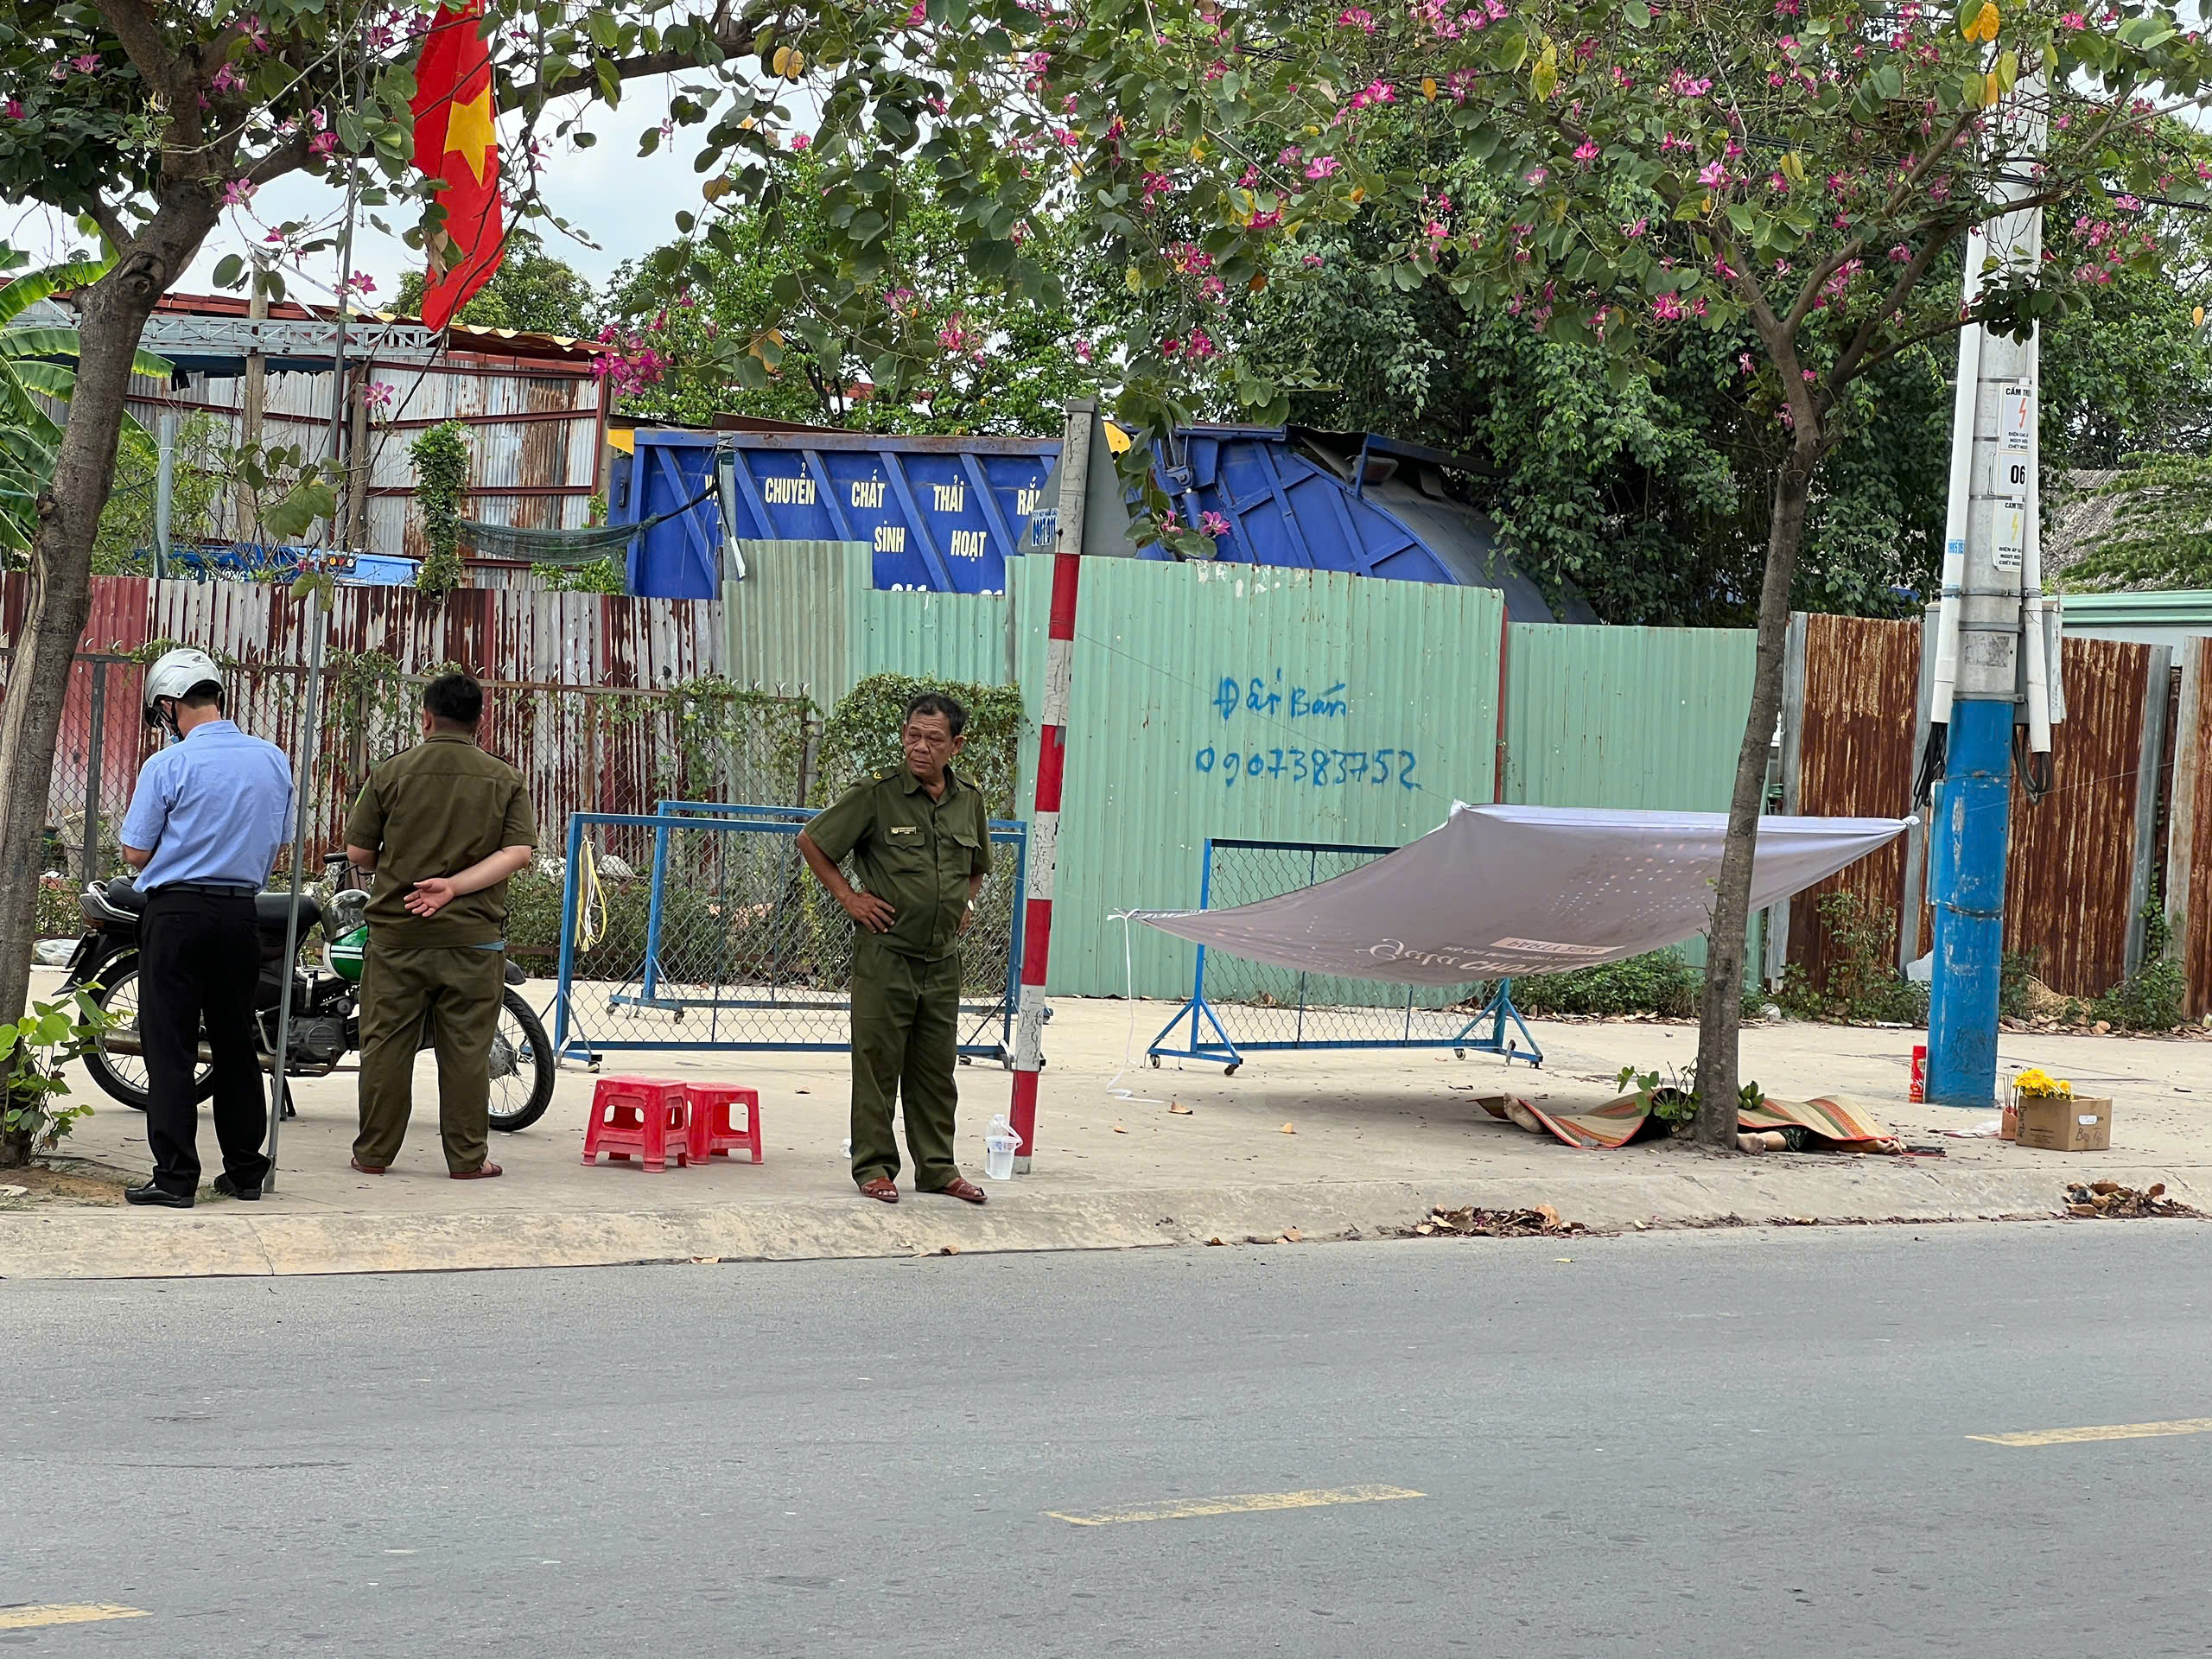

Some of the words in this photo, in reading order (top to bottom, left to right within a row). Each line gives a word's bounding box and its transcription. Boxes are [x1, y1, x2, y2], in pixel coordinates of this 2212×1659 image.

[2005, 386, 2021, 396] CẤM
[765, 462, 816, 505] CHUYỂN
[851, 469, 886, 508] CHẤT
[933, 474, 965, 512] THẢI
[2011, 464, 2025, 484] 06
[874, 520, 906, 553] SINH
[950, 531, 987, 563] HOẠT
[1196, 747, 1424, 791] 0907383752
